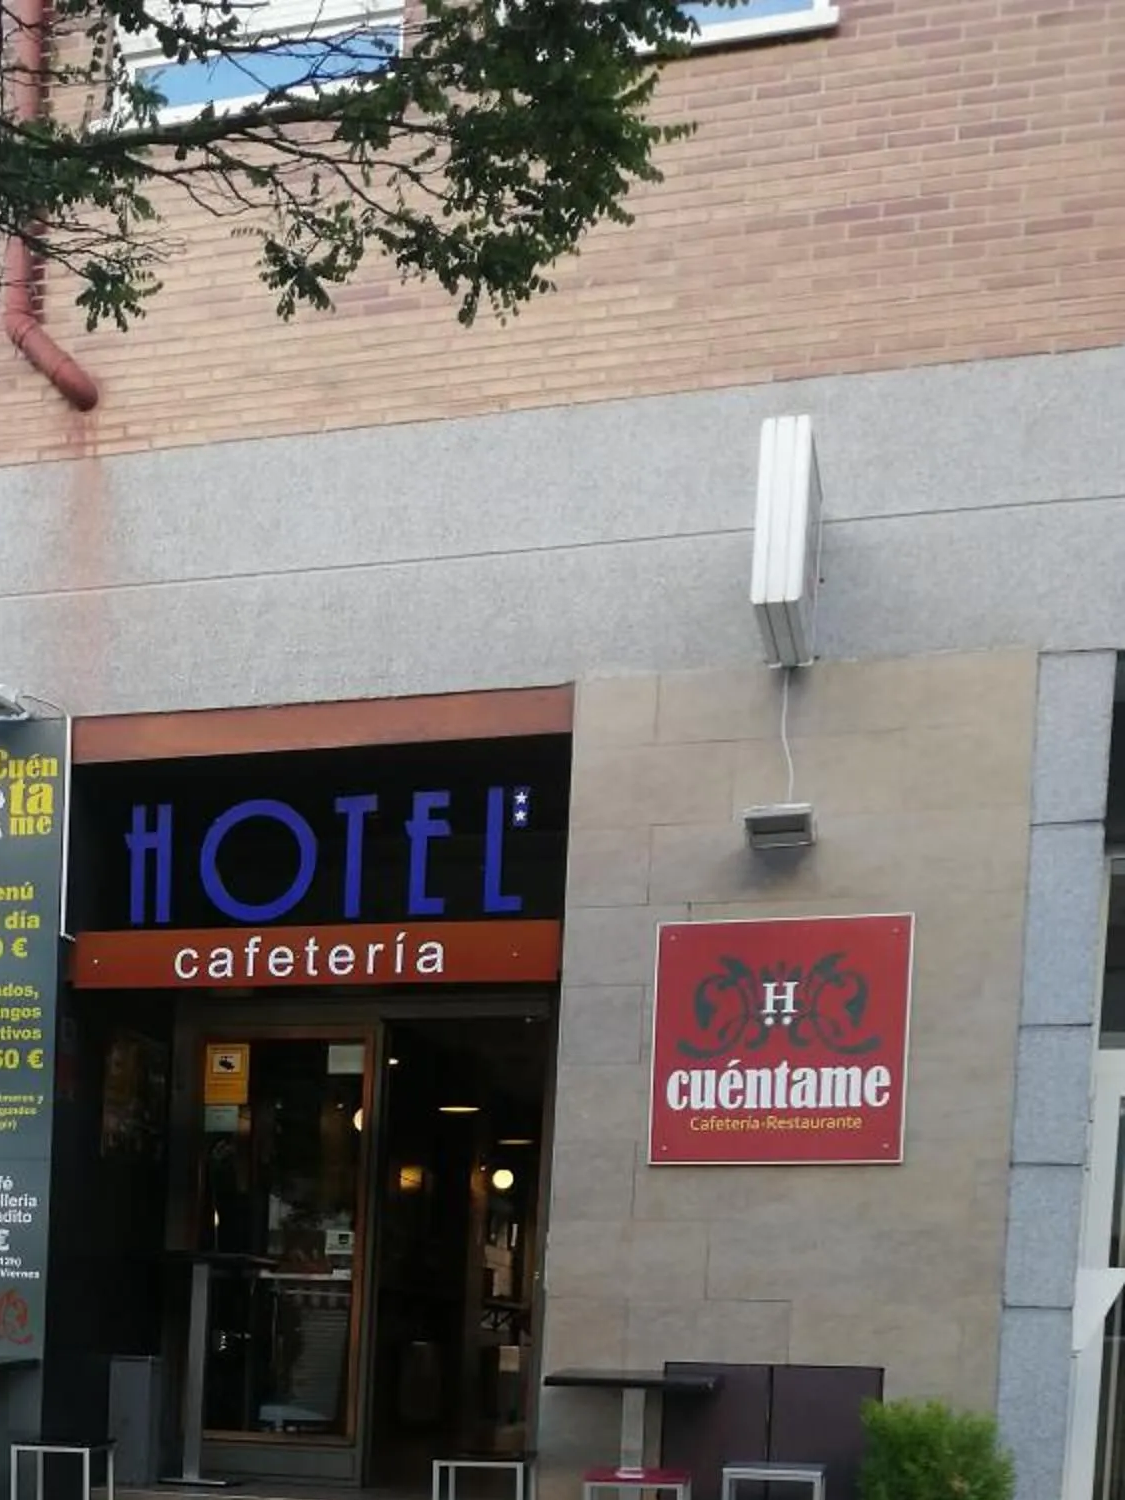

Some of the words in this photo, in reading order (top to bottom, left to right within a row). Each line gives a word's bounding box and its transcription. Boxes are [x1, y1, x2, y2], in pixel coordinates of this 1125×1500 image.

[9, 779, 53, 815] ta
[10, 816, 52, 835] me
[124, 786, 523, 924] HOTEL
[11, 937, 28, 958] €
[175, 931, 445, 979] cafetería
[27, 1047, 44, 1069] €
[666, 1059, 891, 1110] cuéntame
[0, 1268, 41, 1279] Viernes
